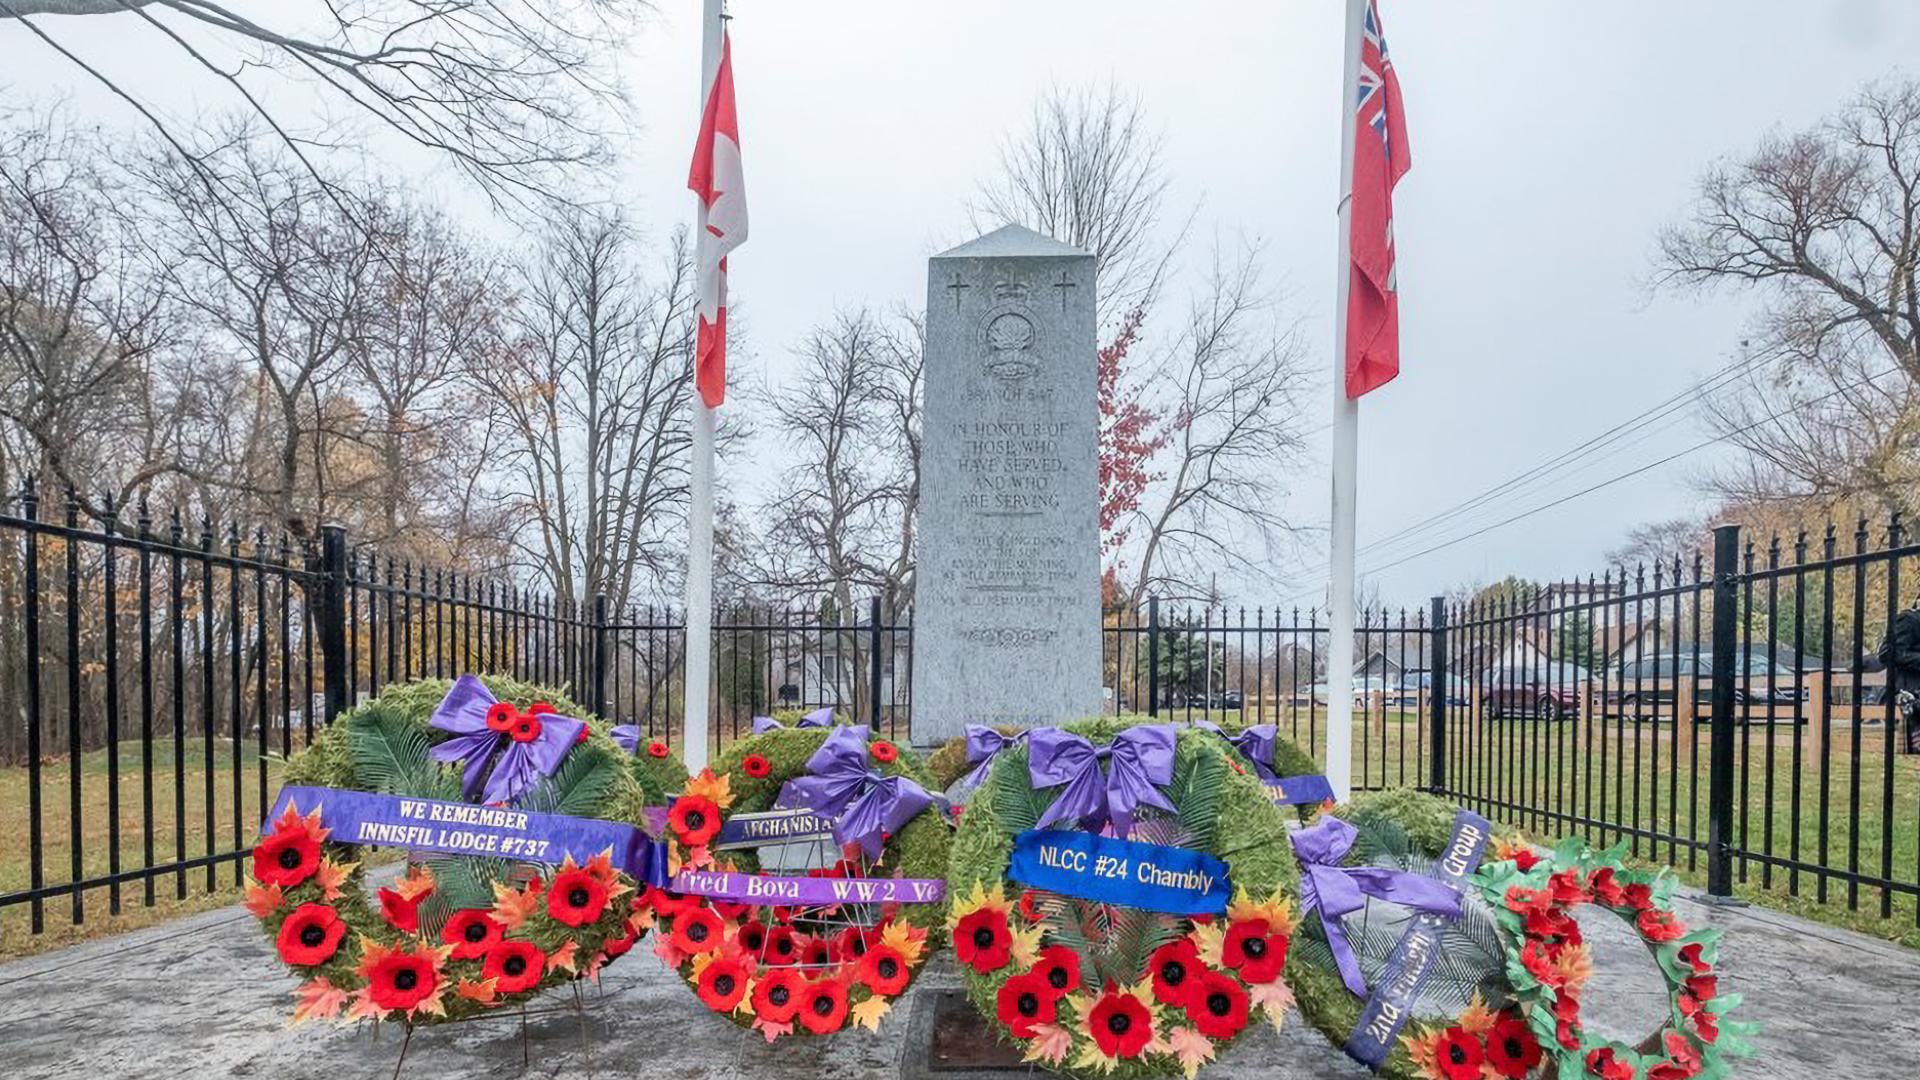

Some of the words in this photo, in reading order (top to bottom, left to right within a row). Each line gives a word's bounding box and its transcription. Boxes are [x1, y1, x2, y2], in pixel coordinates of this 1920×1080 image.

[952, 422, 967, 437] IN
[974, 421, 1045, 437] HONOUR
[1049, 421, 1069, 437] OF
[965, 440, 1016, 455] THOSE
[1021, 440, 1059, 455] WHO
[957, 457, 999, 473] HAVE
[972, 476, 1005, 491] AND
[1010, 476, 1049, 491] WHO
[960, 494, 990, 509] ARE
[994, 494, 1060, 509] SERVING
[399, 800, 426, 819] WE
[429, 803, 529, 831] REMEMBER
[358, 822, 434, 847] INNISFIL
[438, 829, 499, 852] LODGE
[499, 836, 550, 857] #737
[1039, 846, 1087, 873] NLCC
[1094, 855, 1129, 880] #24
[1137, 862, 1213, 897] Chambly
[746, 876, 800, 898] Bova
[1365, 1003, 1402, 1046] 2nd
[1442, 823, 1481, 877] Group
